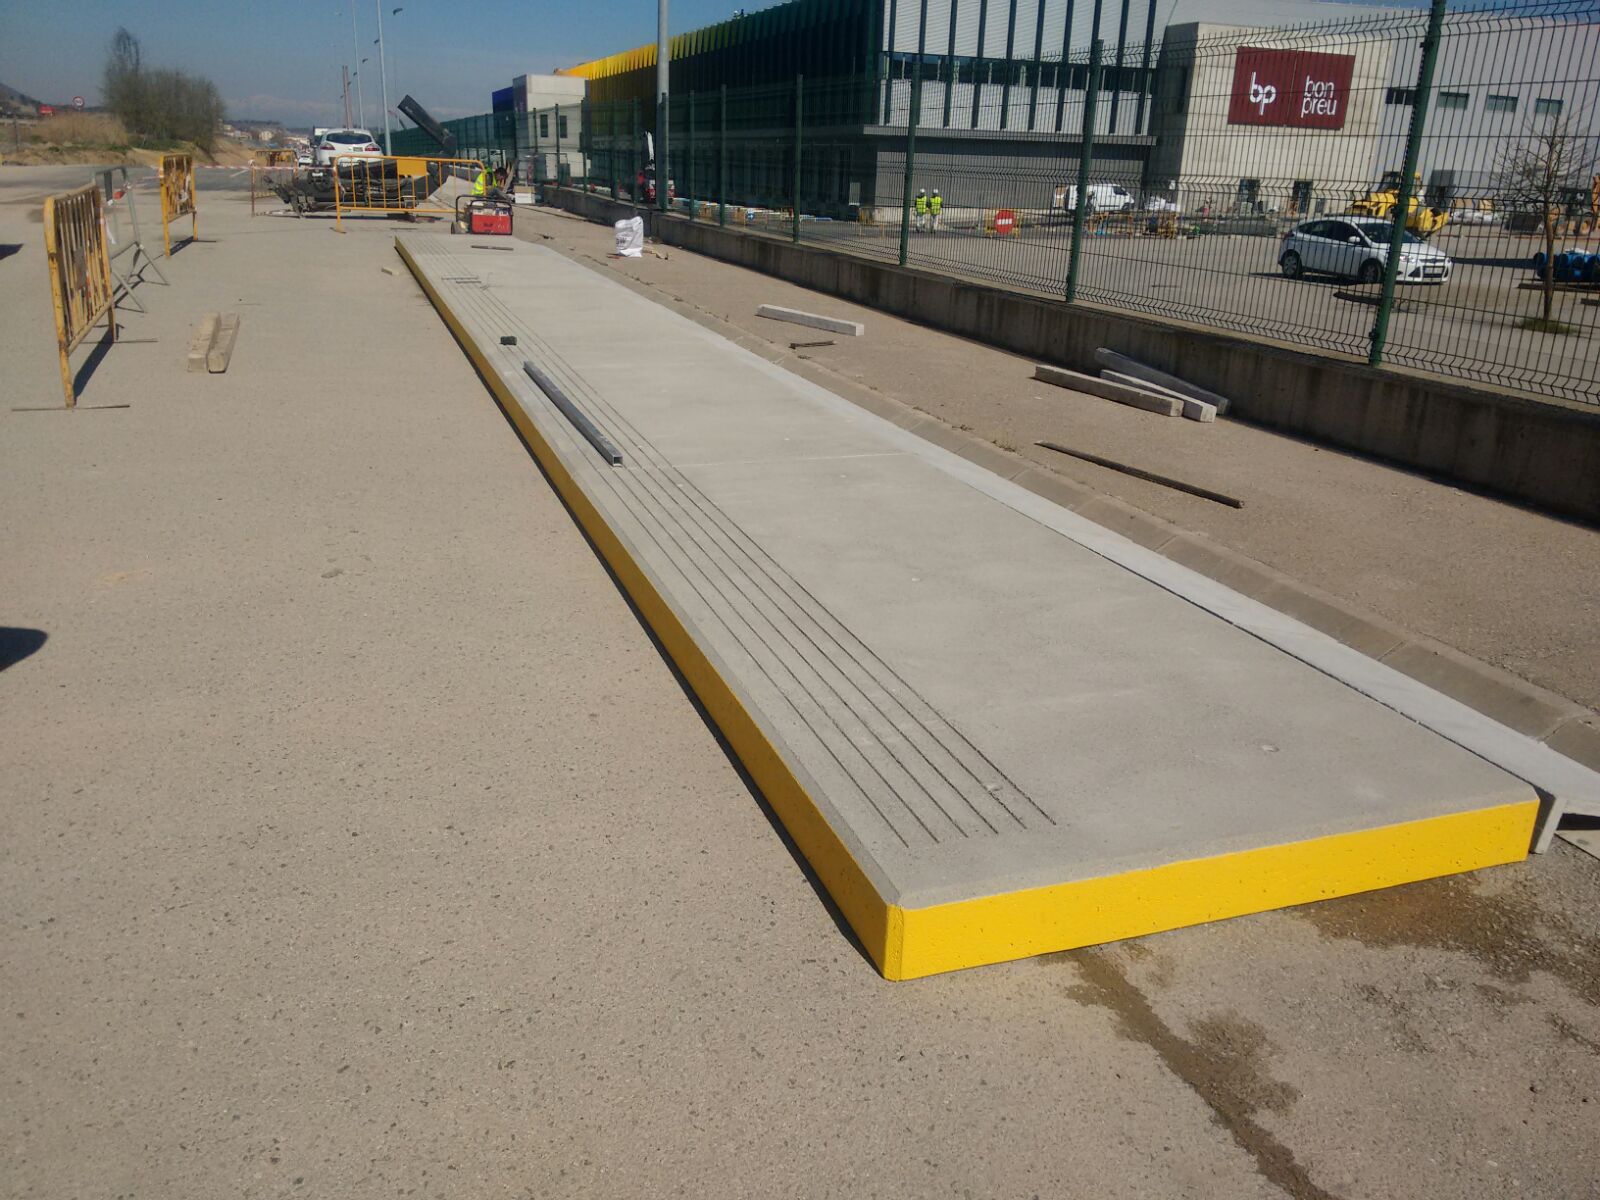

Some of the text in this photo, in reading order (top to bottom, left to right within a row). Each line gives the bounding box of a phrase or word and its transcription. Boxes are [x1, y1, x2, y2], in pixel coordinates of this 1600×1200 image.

[1249, 71, 1277, 116] bp
[1304, 75, 1335, 99] bon
[1300, 96, 1337, 118] preu
